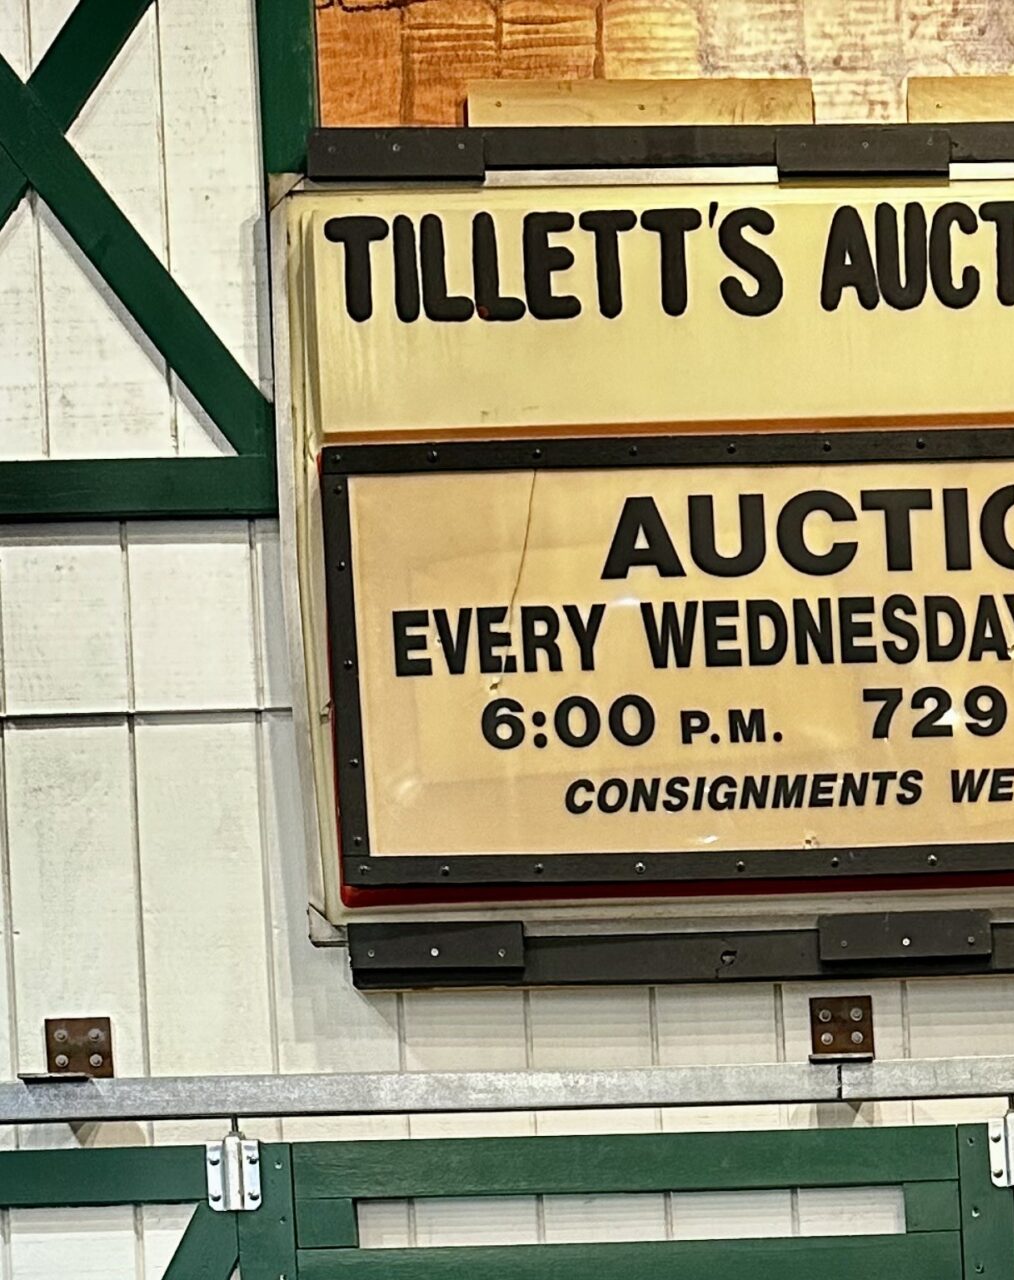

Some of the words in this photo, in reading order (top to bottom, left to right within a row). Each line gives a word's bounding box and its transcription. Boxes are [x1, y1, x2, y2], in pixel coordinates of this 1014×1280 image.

[323, 201, 784, 324] TILLETT'S
[391, 603, 607, 678] EVERY
[480, 694, 656, 751] 6:00
[679, 708, 783, 745] P.M.
[564, 769, 924, 815] CONSIGNMENTS
